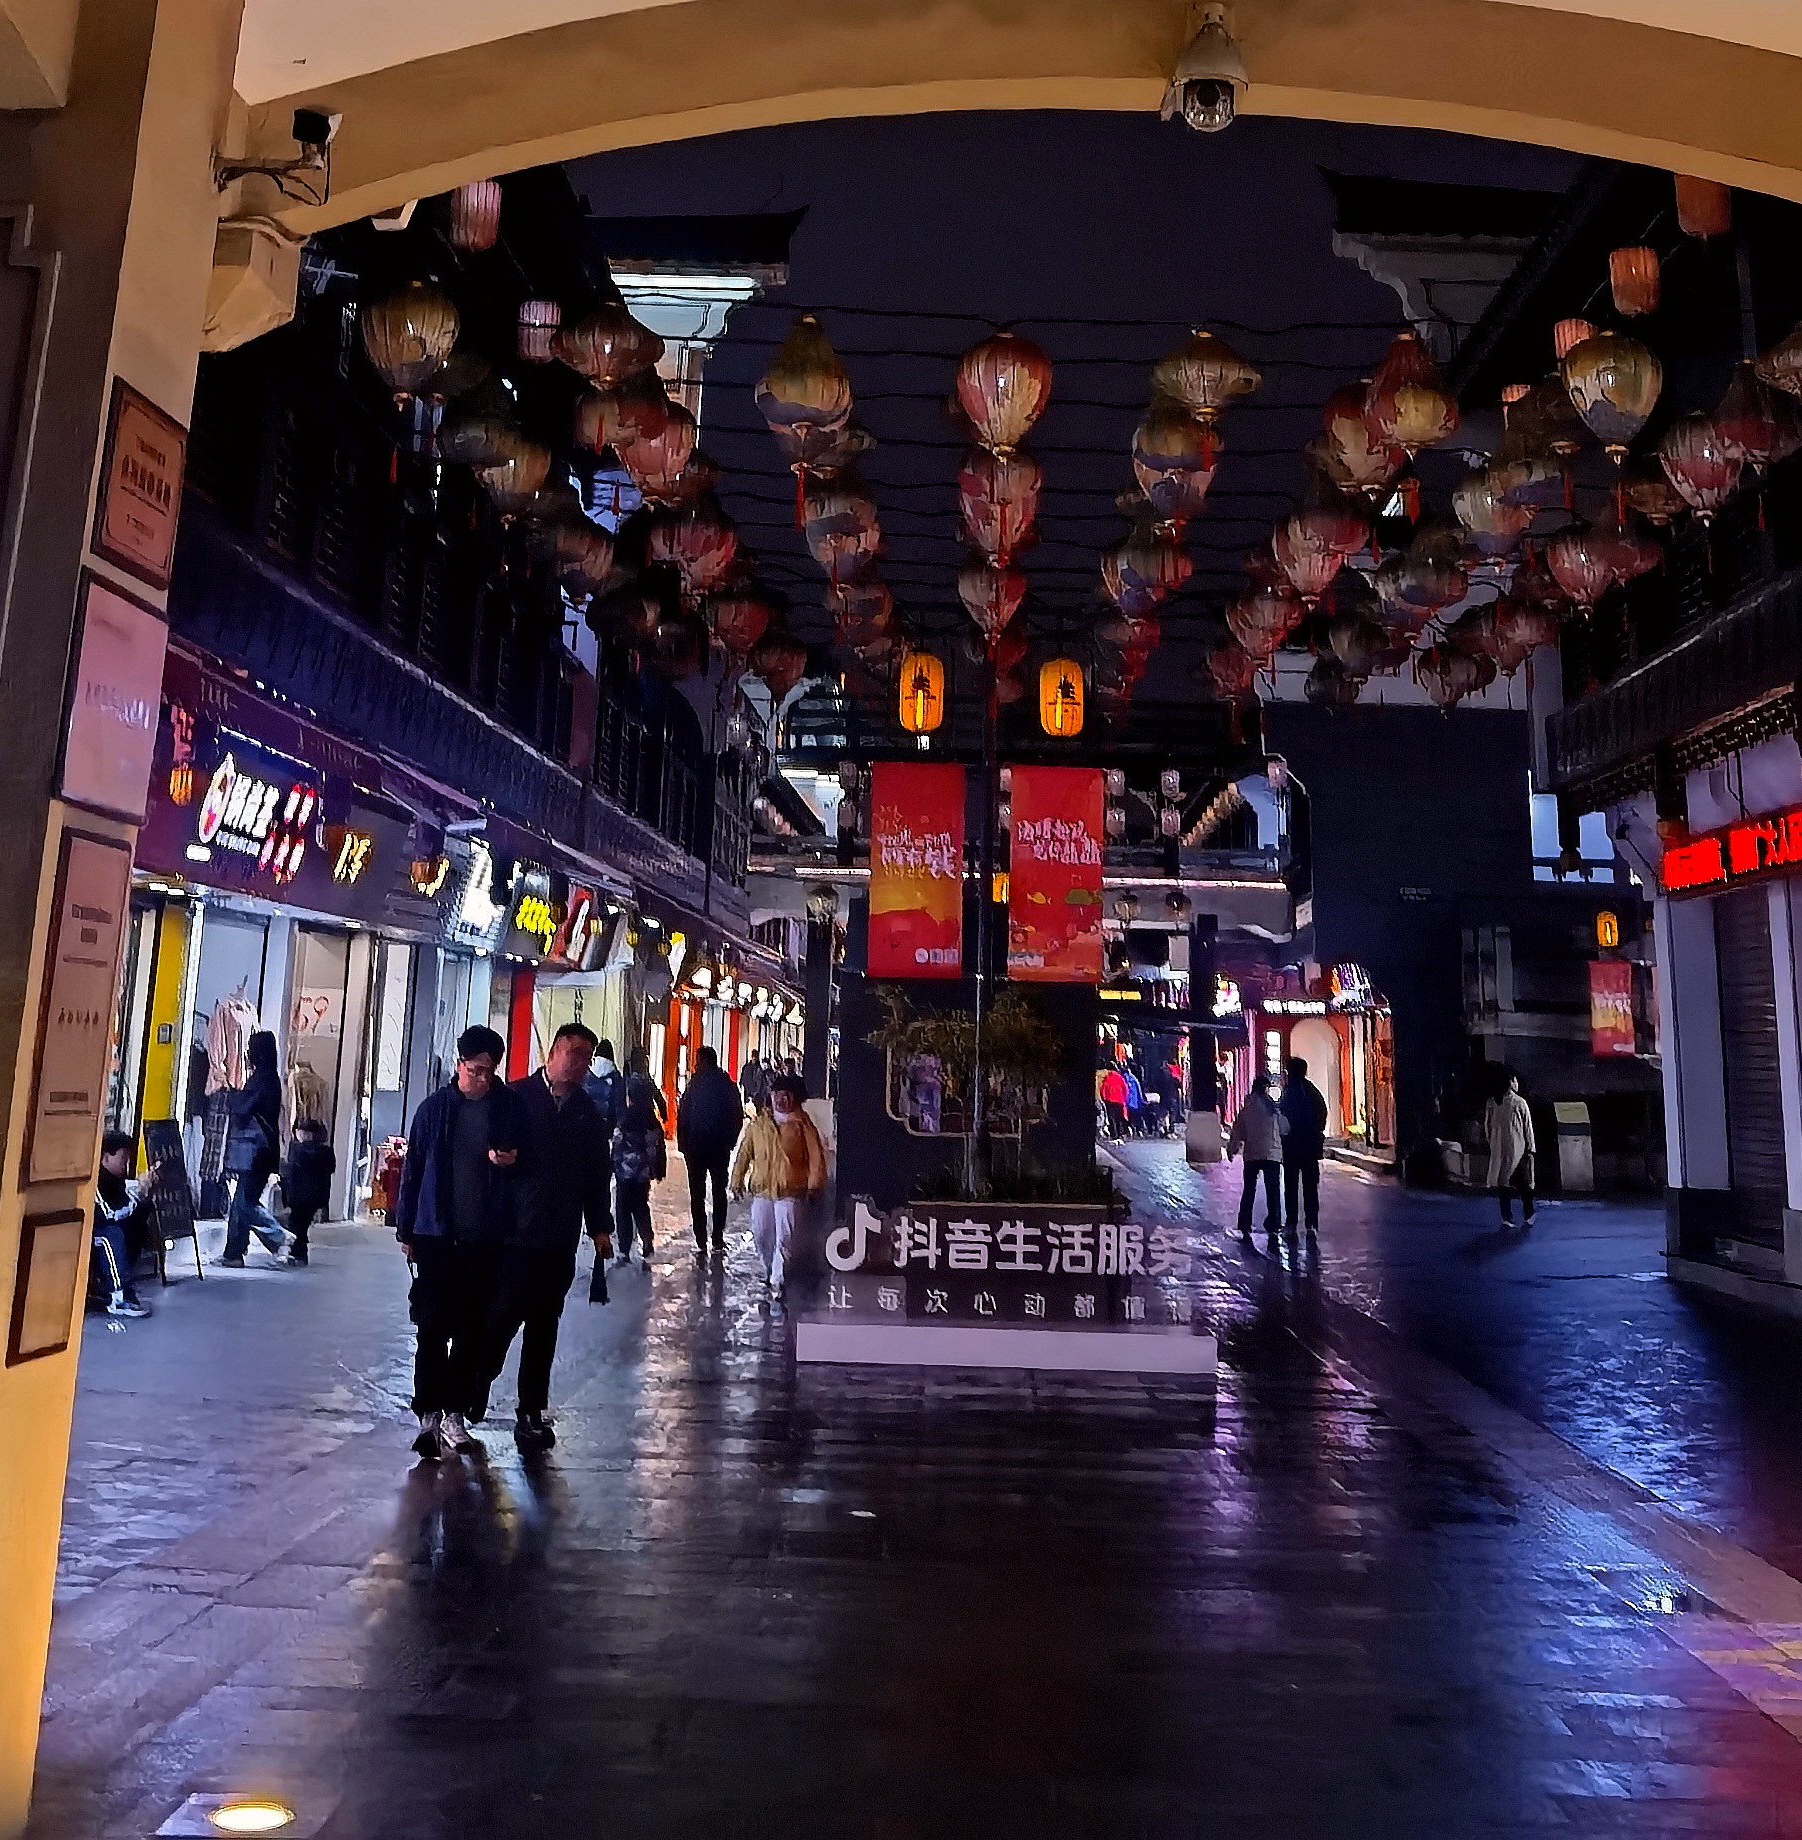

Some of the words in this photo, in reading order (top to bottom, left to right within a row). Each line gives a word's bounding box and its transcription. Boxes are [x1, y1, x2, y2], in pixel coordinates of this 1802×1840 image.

[893, 1214, 1194, 1276] 抖音生活服务
